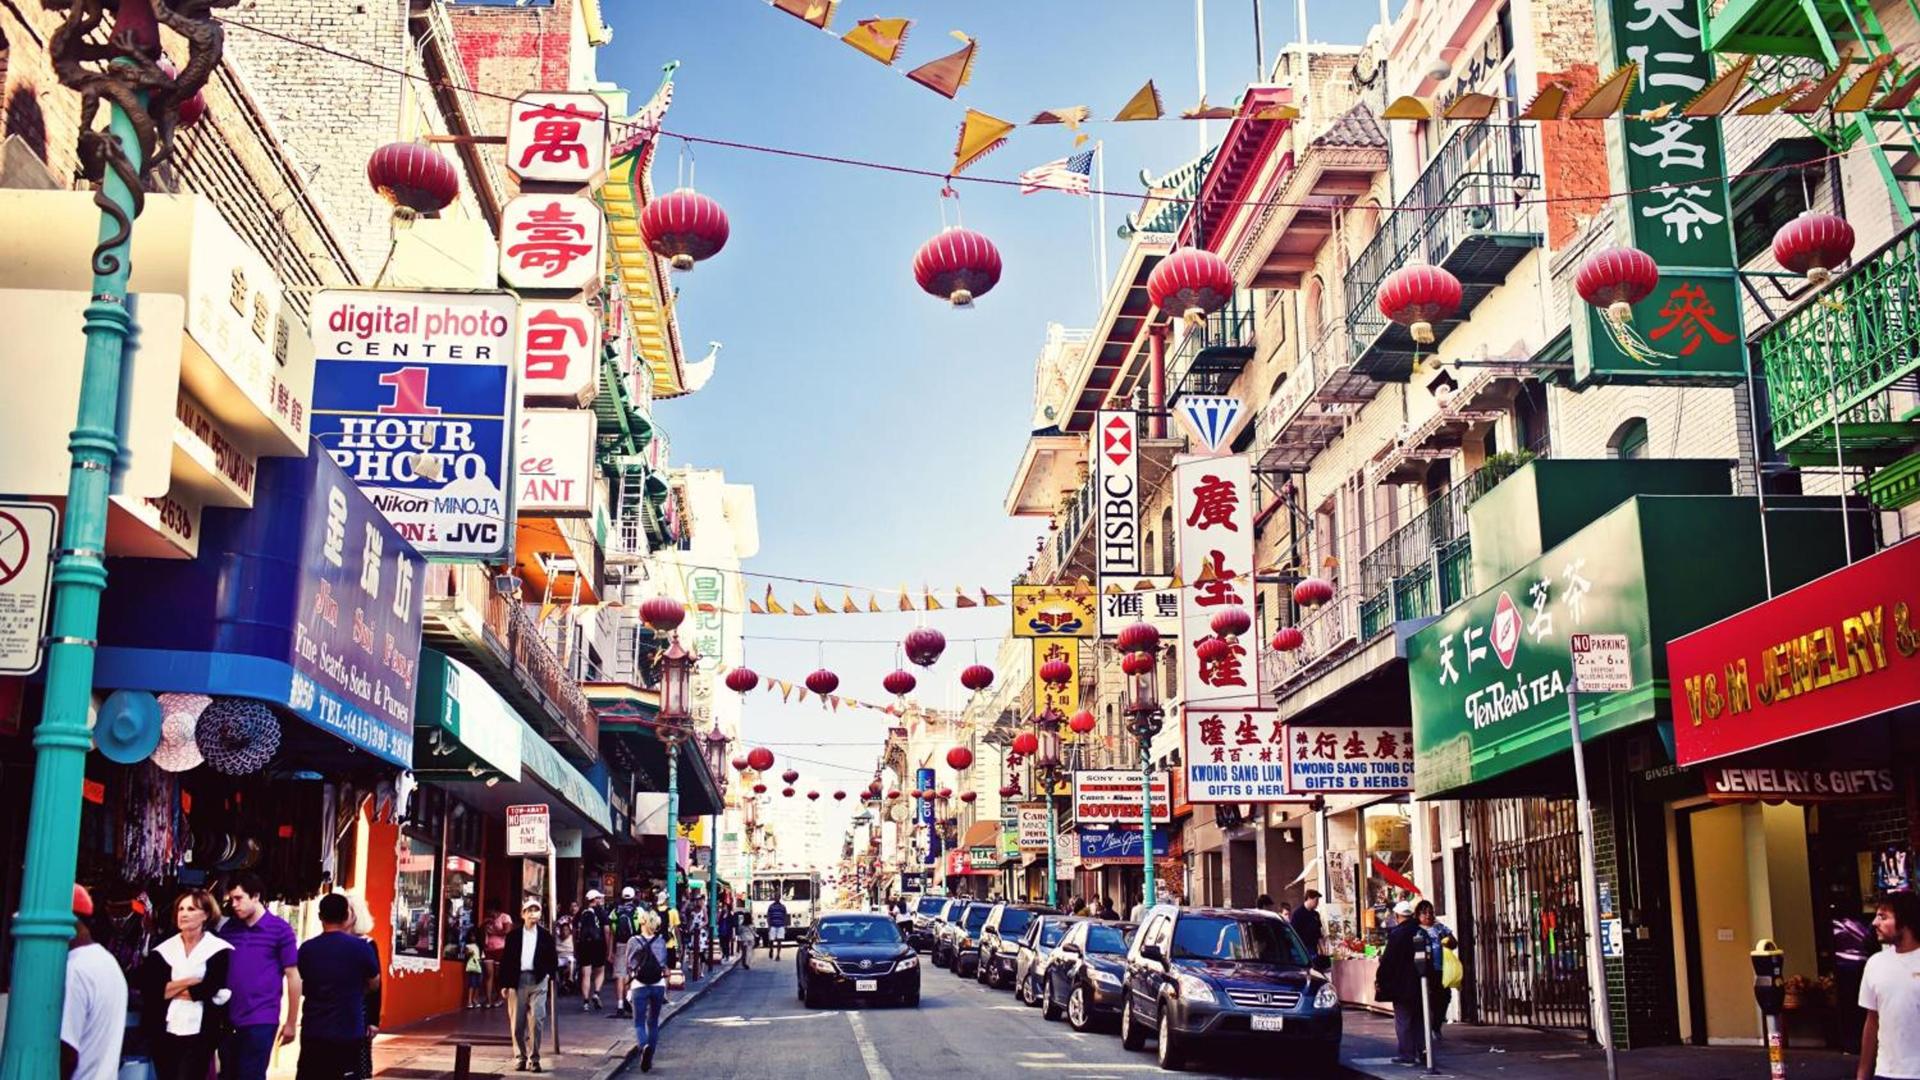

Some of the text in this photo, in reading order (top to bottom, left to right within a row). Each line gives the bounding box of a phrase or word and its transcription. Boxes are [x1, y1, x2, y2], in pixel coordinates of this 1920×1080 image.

[329, 304, 508, 341] digital photo
[336, 341, 491, 359] CENTER
[378, 366, 442, 415] 1
[337, 418, 475, 451] HOUR
[330, 450, 487, 483] PHOTO
[522, 479, 575, 502] ANT
[373, 495, 428, 512] Nikon
[1105, 475, 1134, 568] HSBC
[446, 523, 497, 543] JVC
[1573, 636, 1626, 651] NO PARKING
[1439, 625, 1488, 686] 天仁
[1684, 675, 1702, 727] V
[1725, 658, 1751, 715] M
[1755, 605, 1888, 704] JEWELRY
[1530, 669, 1565, 706] TEA
[382, 685, 410, 724] Purses
[1192, 765, 1282, 782] KWONG SANG LUN
[1294, 762, 1335, 775] KWONG
[1337, 762, 1368, 774] SANG
[1371, 762, 1400, 774] TONG
[1306, 776, 1409, 788] GIFTS & HERBS
[1716, 769, 1894, 792] JEWELRY & GIFTS
[1208, 785, 1241, 796] GIFTS
[1246, 785, 1253, 796] &
[510, 815, 519, 825] NO
[1078, 803, 1168, 818] SOUVENRS
[520, 827, 535, 835] ANY
[520, 836, 535, 844] TIME
[970, 850, 988, 859] TEA
